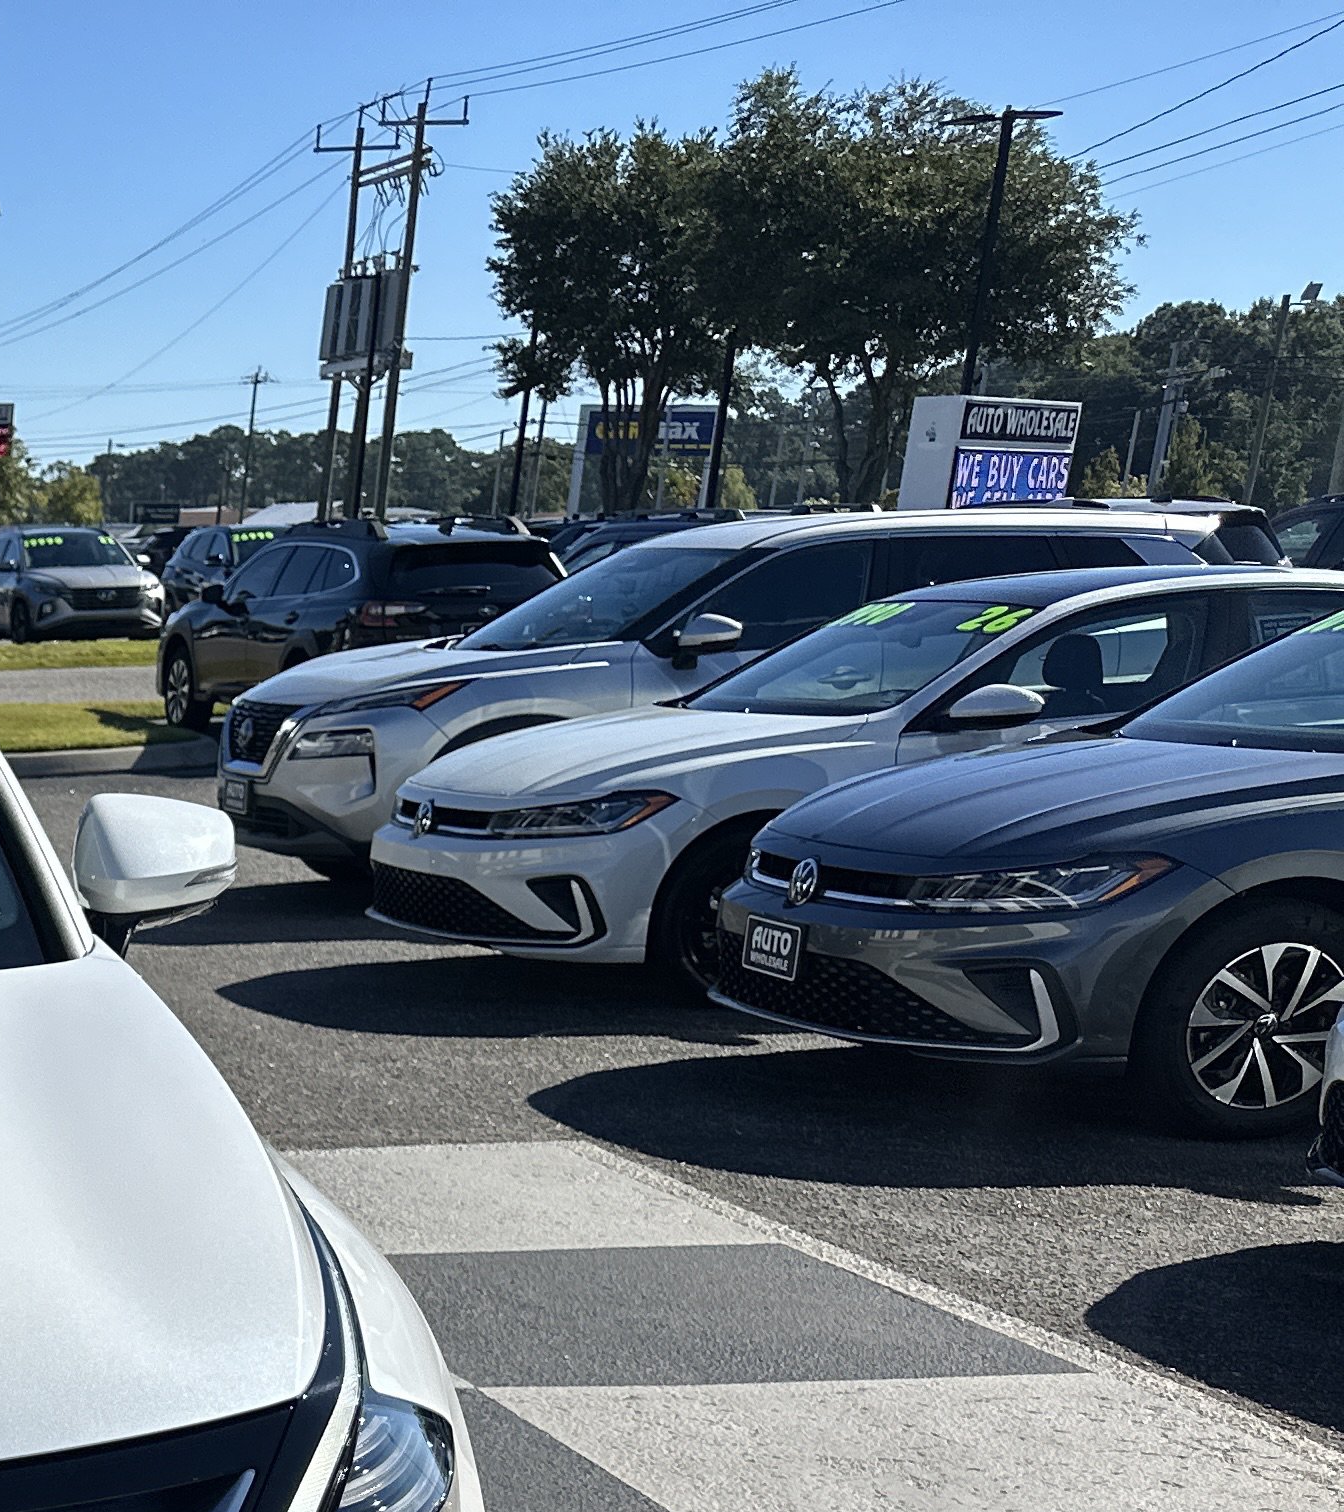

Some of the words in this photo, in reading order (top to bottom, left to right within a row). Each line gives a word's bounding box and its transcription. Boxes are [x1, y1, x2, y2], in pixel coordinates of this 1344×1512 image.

[966, 406, 1004, 435] AUTO
[1005, 408, 1077, 439] WHOLESALE
[956, 453, 983, 488] WE
[986, 455, 1024, 490] BUY
[1027, 456, 1070, 490] CARS
[956, 605, 1034, 634] 26
[752, 925, 792, 956] AUTO
